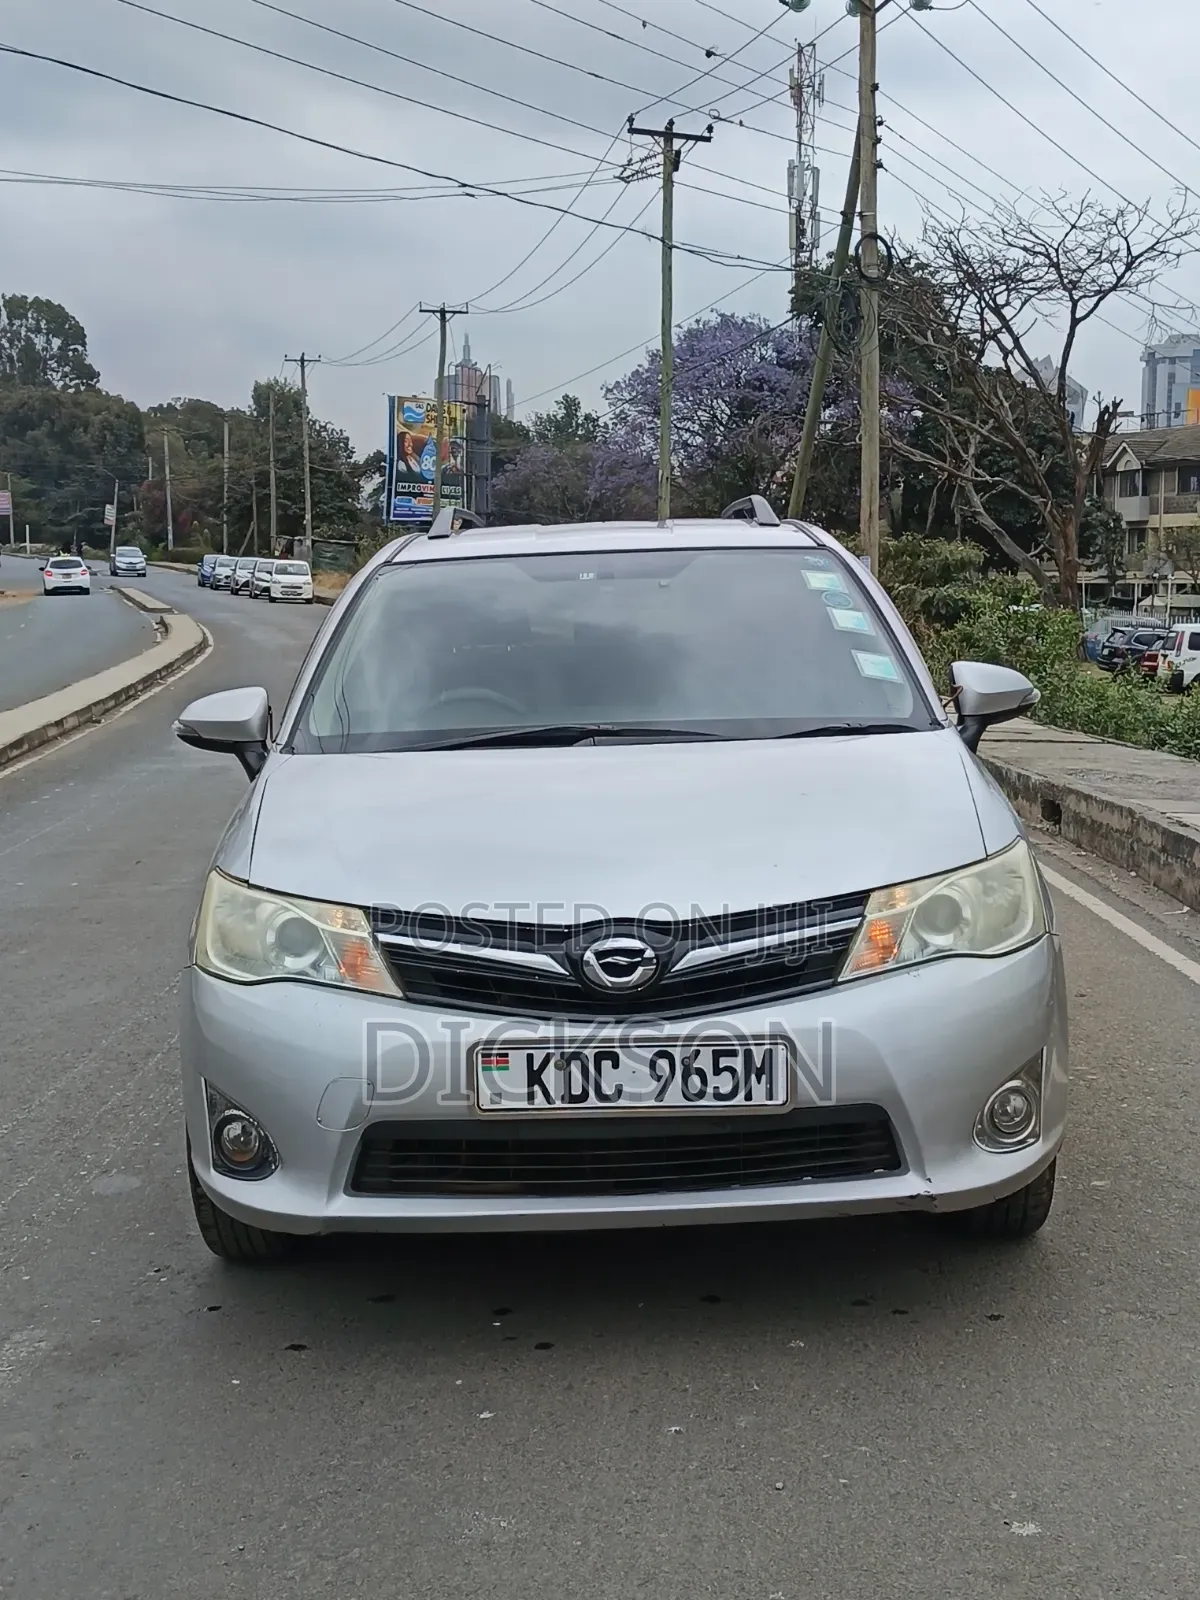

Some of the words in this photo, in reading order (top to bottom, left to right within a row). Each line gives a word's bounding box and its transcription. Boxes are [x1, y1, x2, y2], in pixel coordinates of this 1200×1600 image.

[397, 483, 435, 494] IMPROVIN
[526, 1050, 623, 1105] KDC
[649, 1048, 774, 1102] 965M
